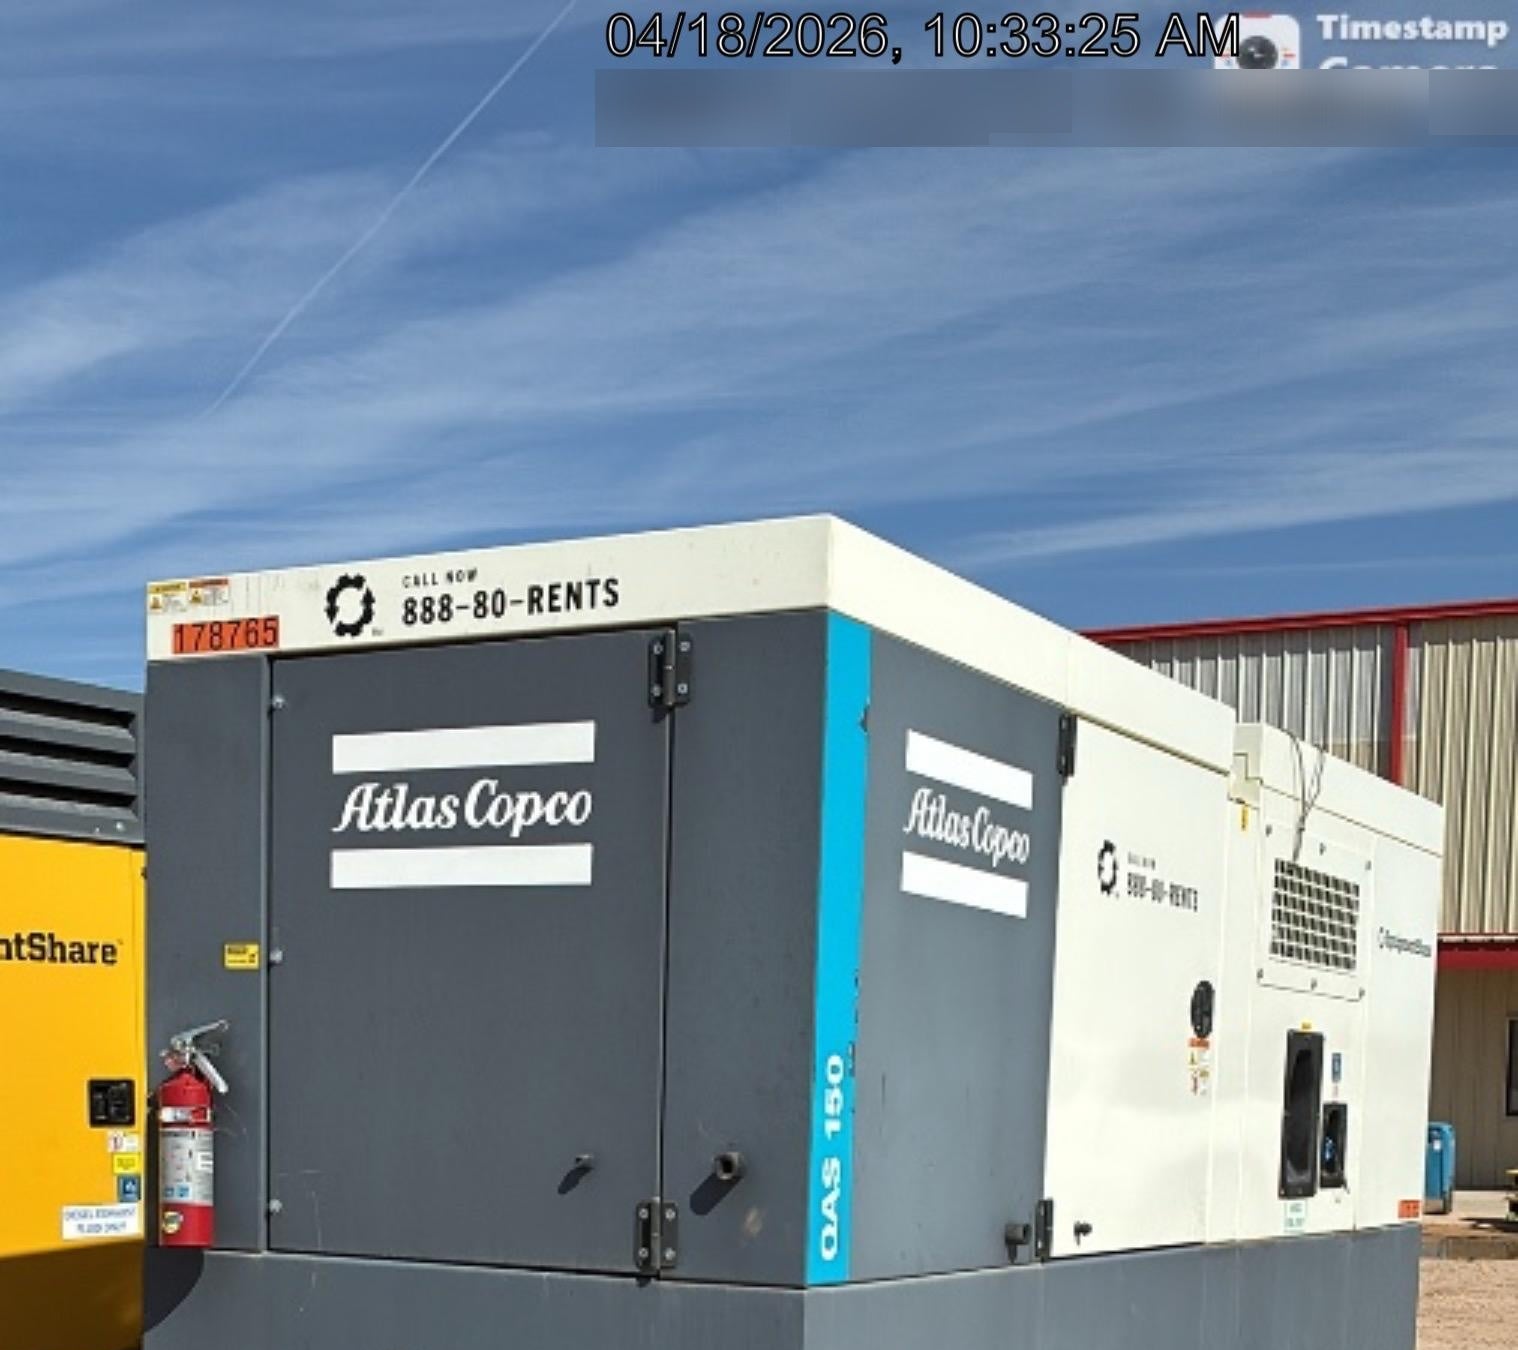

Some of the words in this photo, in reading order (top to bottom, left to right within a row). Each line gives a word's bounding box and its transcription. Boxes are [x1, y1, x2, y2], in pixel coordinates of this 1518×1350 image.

[402, 572, 438, 588] CALL
[447, 567, 478, 583] NOW
[402, 578, 619, 626] 888-80-RENTS
[174, 617, 278, 654] 178765
[824, 1055, 844, 1141] 150
